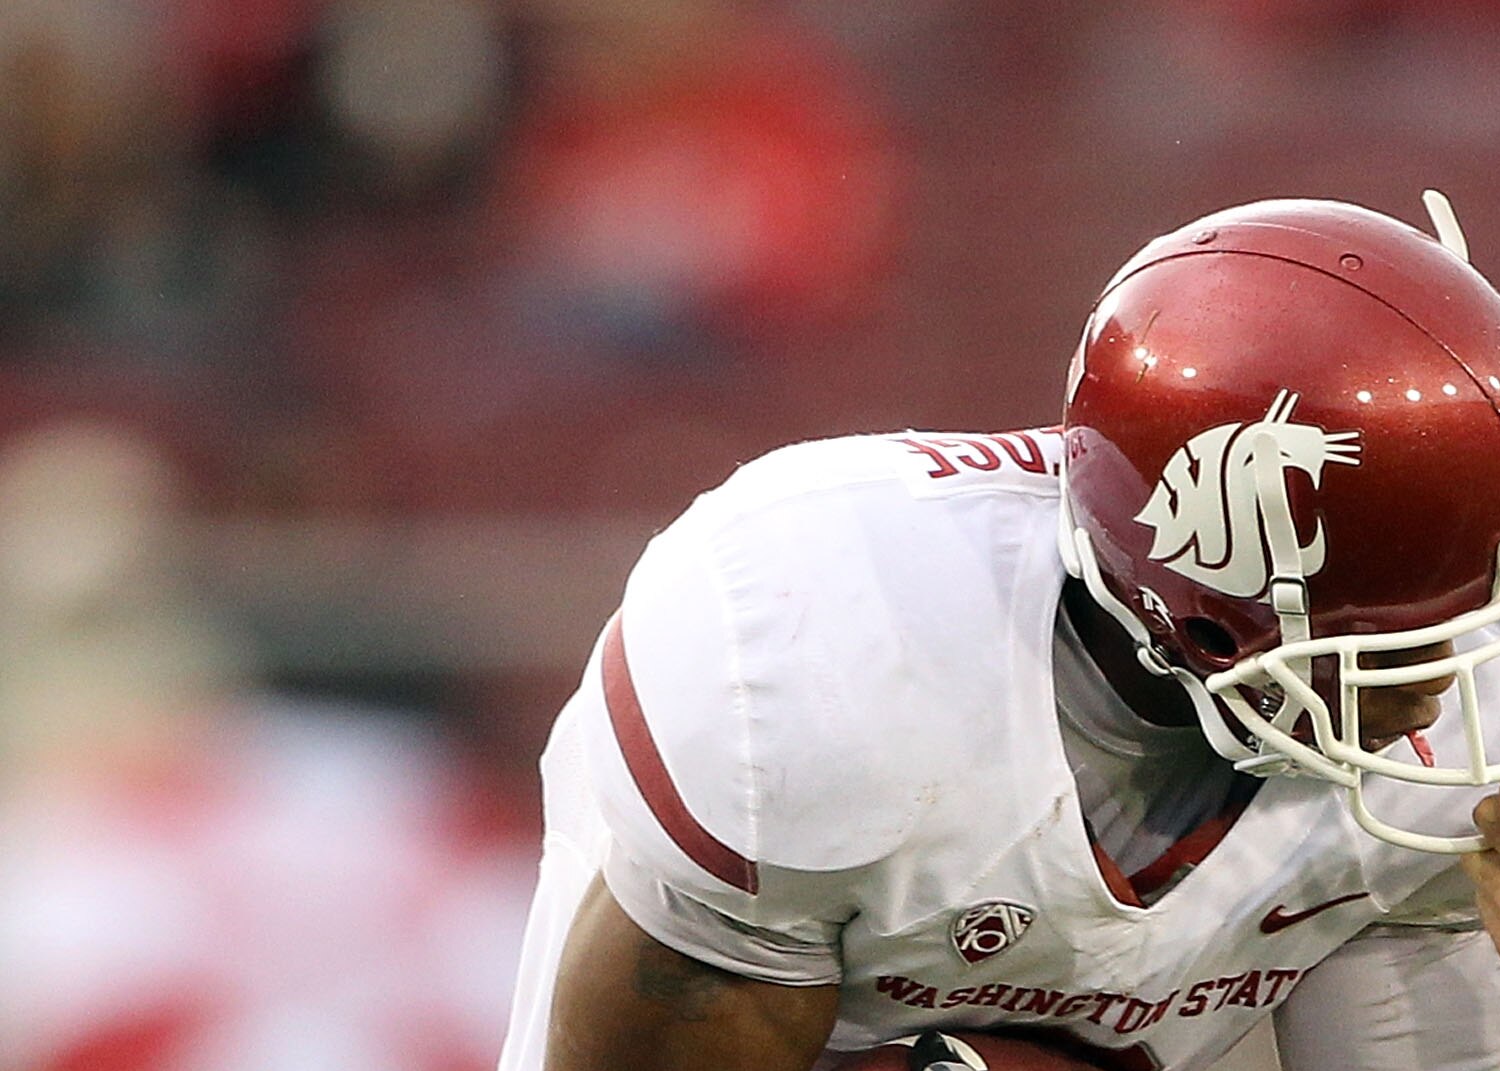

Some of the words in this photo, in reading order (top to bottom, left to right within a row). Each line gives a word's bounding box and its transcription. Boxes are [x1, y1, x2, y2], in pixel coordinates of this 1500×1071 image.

[960, 929, 1007, 953] 10
[876, 975, 1180, 1034] WASHINGTON
[1178, 969, 1304, 1018] STAT
